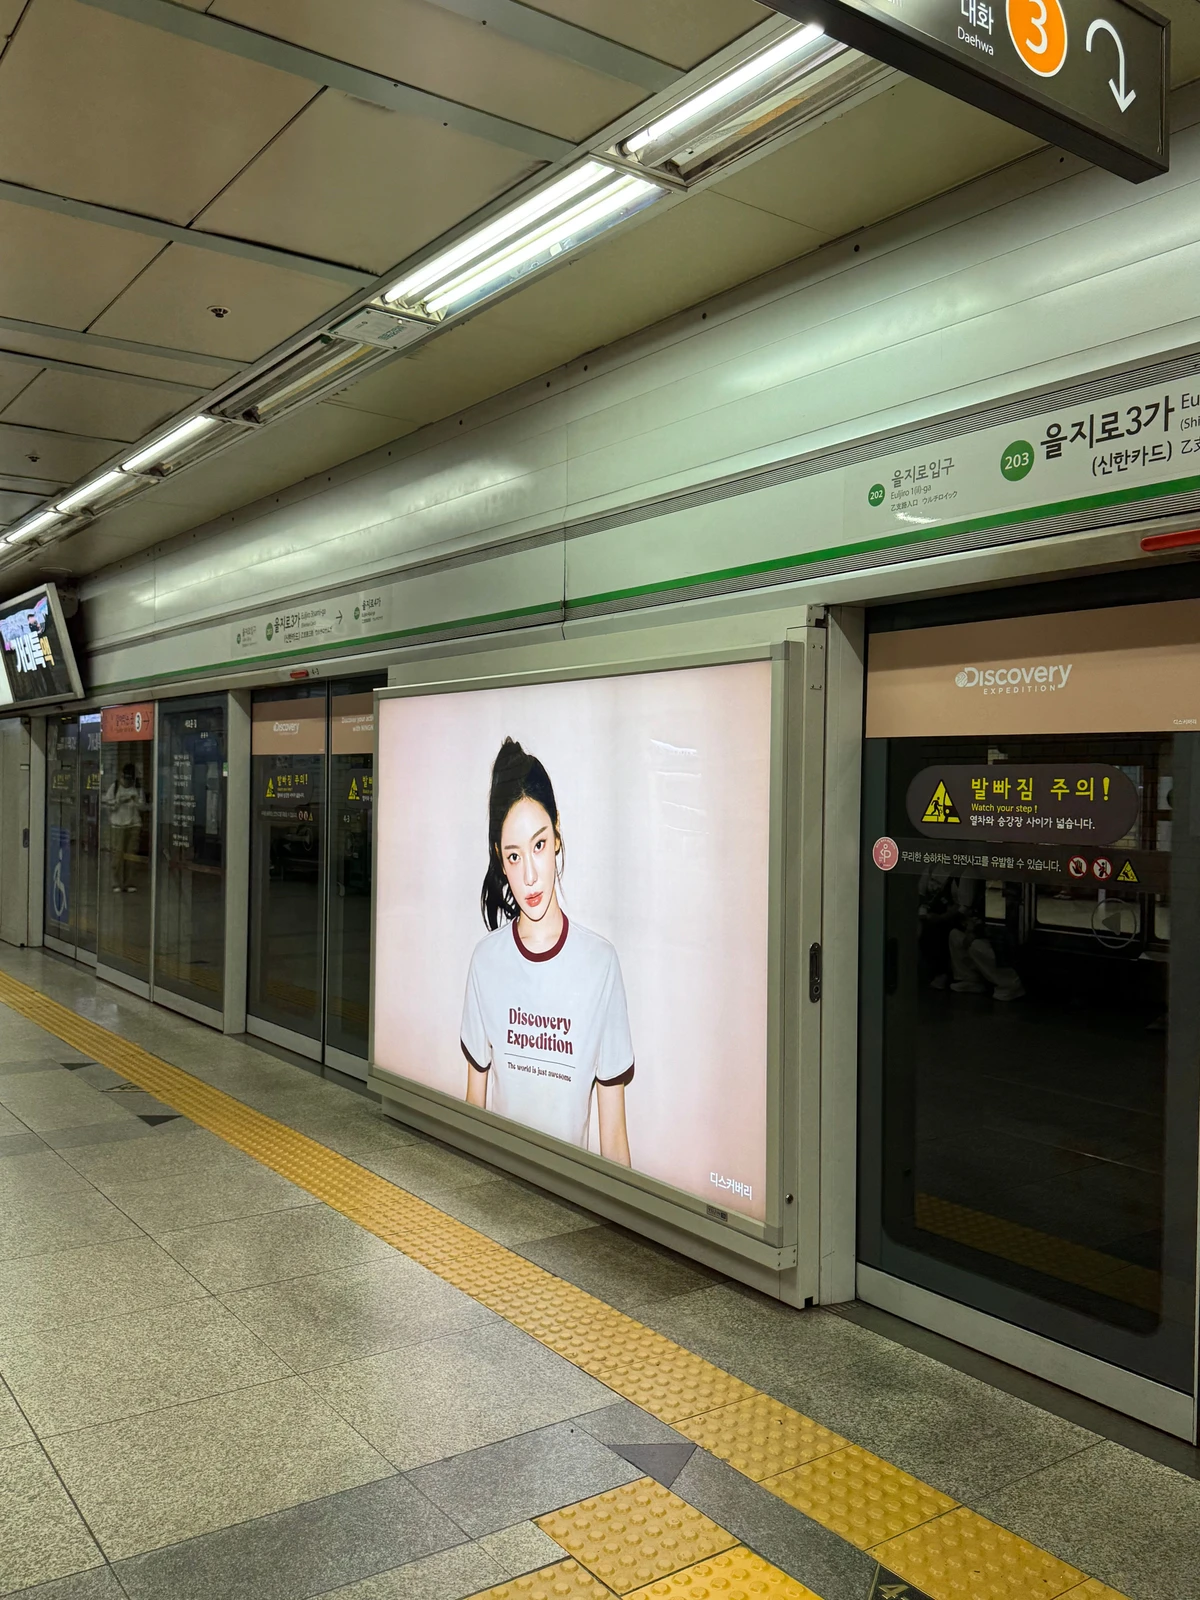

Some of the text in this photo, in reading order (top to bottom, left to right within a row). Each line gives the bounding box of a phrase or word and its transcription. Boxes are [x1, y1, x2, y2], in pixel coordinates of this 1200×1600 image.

[960, 0, 995, 35] 대화
[1025, 0, 1048, 55] 3
[957, 26, 994, 56] Daehwa
[1040, 395, 1175, 460] 을지로3가
[1004, 452, 1030, 470] 203
[1092, 440, 1172, 477] (신한카드)
[891, 457, 955, 488] 을지로입구
[869, 489, 884, 501] 202
[955, 664, 1073, 689] Discovery
[983, 685, 1056, 695] EXPEDITION
[971, 777, 1110, 801] 발빠짐 주의!
[971, 803, 995, 812] Watch
[996, 804, 1015, 814] your
[1015, 804, 1033, 814] step
[969, 814, 1096, 830] 열차와 승강장 사이가 넓습니다.
[901, 851, 1062, 872] 무리한 승하차는 안전사고를 유발할 수 있습니다.
[508, 1006, 571, 1036] Discovery
[506, 1029, 574, 1056] Expedition
[507, 1061, 572, 1082] The world is just awesome
[709, 1171, 753, 1201] 디스커버리
